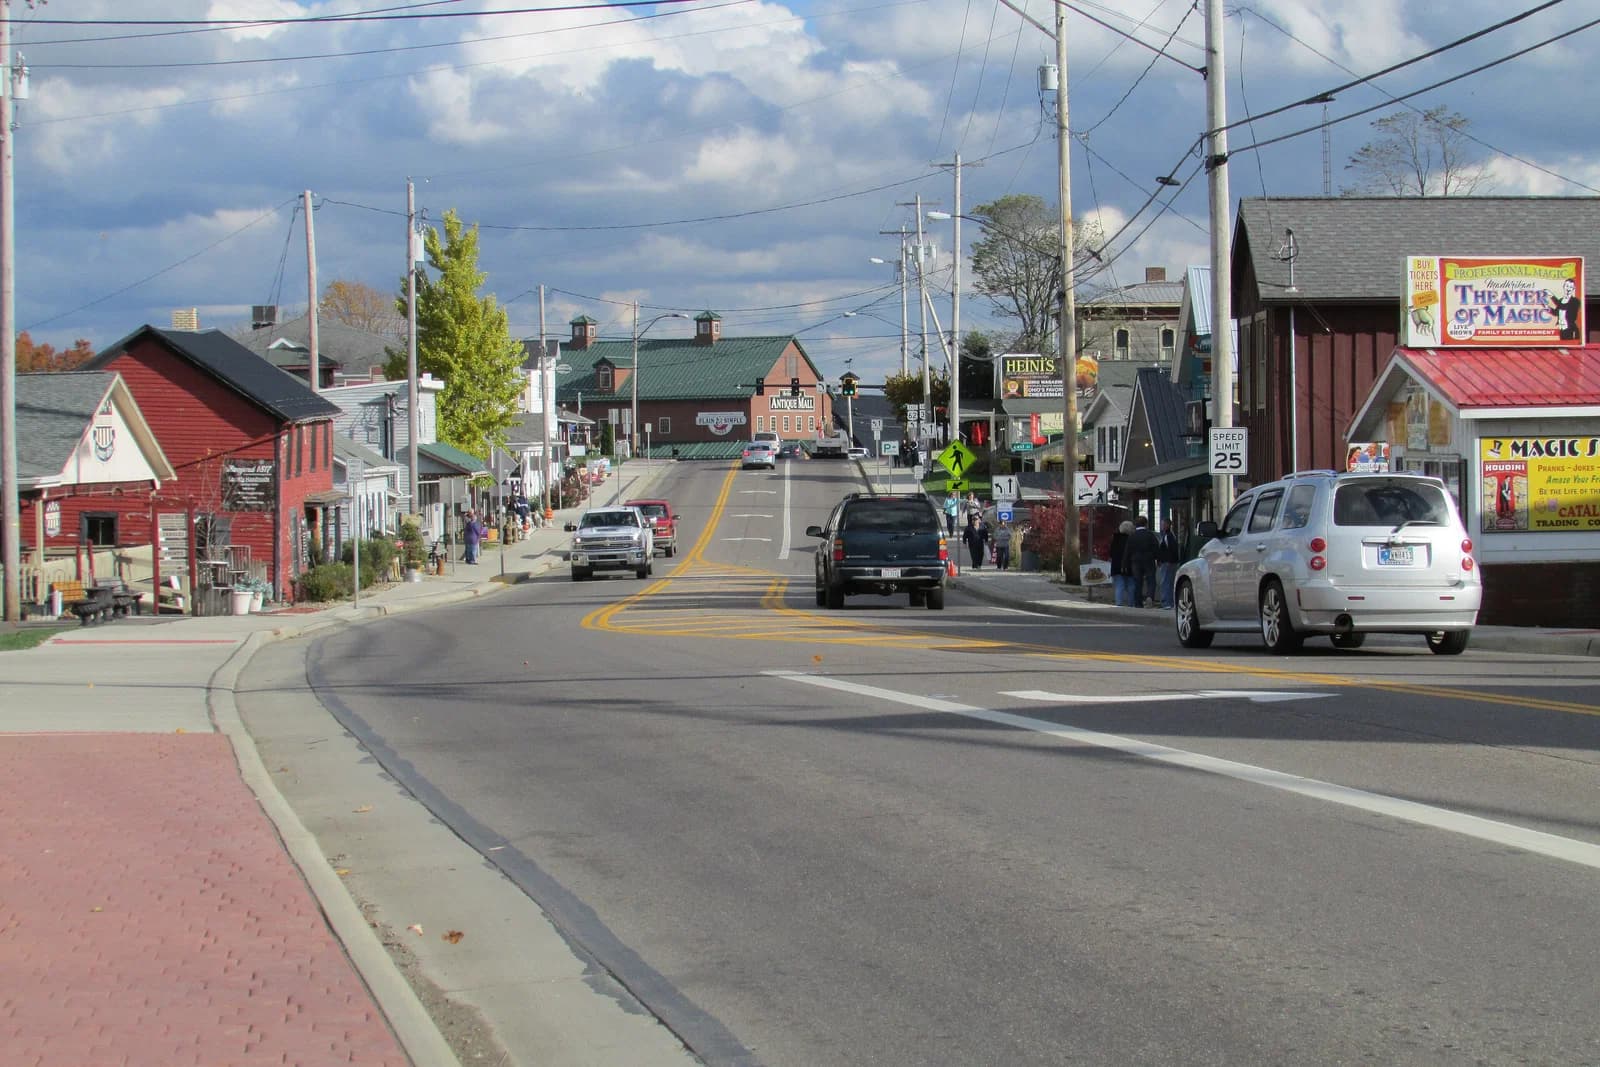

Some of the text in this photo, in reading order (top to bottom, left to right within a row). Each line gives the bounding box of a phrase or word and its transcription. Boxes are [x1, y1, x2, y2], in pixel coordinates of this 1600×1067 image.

[1417, 259, 1431, 269] BUY
[1410, 270, 1438, 280] TICKETS
[1454, 266, 1568, 279] PROFESSIONAL MAGIC
[1416, 281, 1433, 290] HERE
[1454, 284, 1549, 306] THEATER
[1454, 306, 1552, 326] OF MAGIC
[1511, 440, 1580, 457] MAGIC
[1214, 452, 1242, 469] 25
[1546, 476, 1570, 484] Amaze
[1574, 476, 1588, 484] Your
